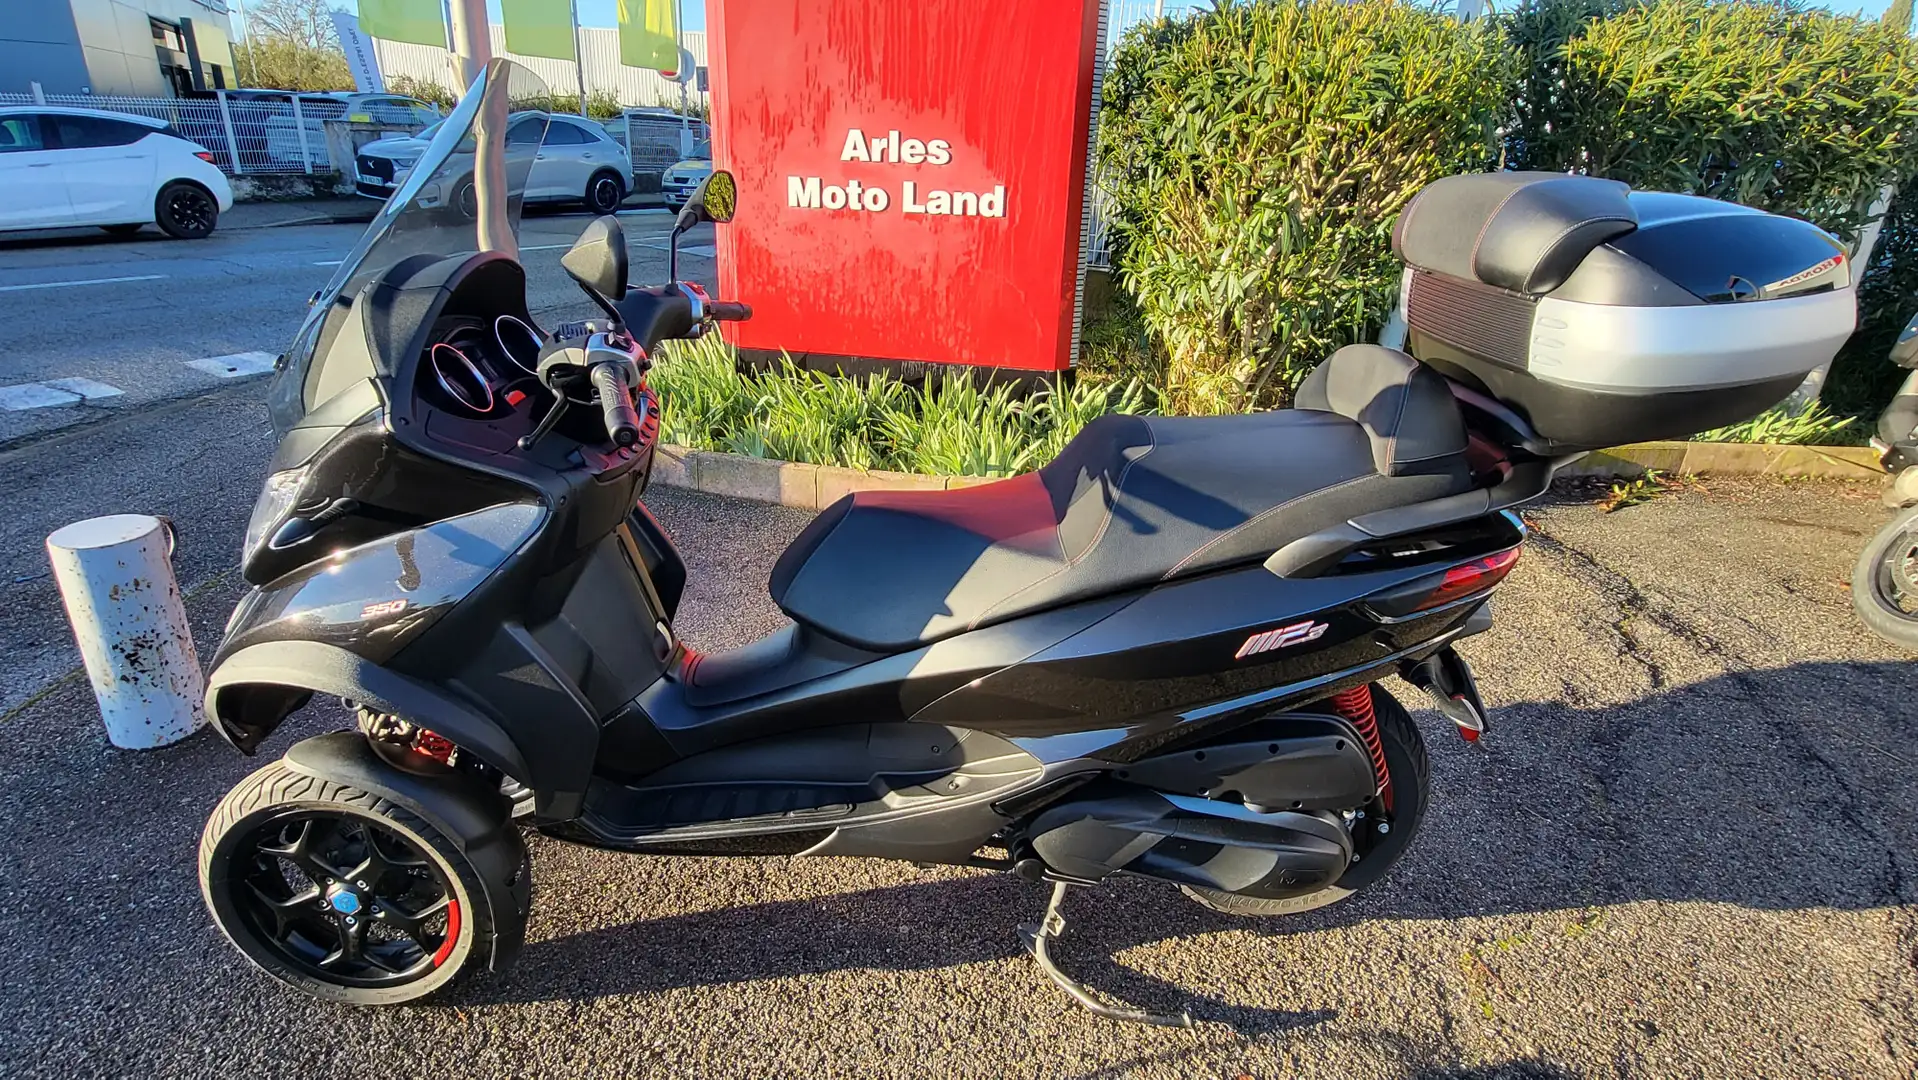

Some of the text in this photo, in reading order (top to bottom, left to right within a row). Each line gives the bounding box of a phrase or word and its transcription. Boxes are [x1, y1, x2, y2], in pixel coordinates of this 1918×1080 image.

[840, 128, 952, 166] Arles
[787, 175, 1007, 218] Moto Land
[360, 599, 408, 618] 350
